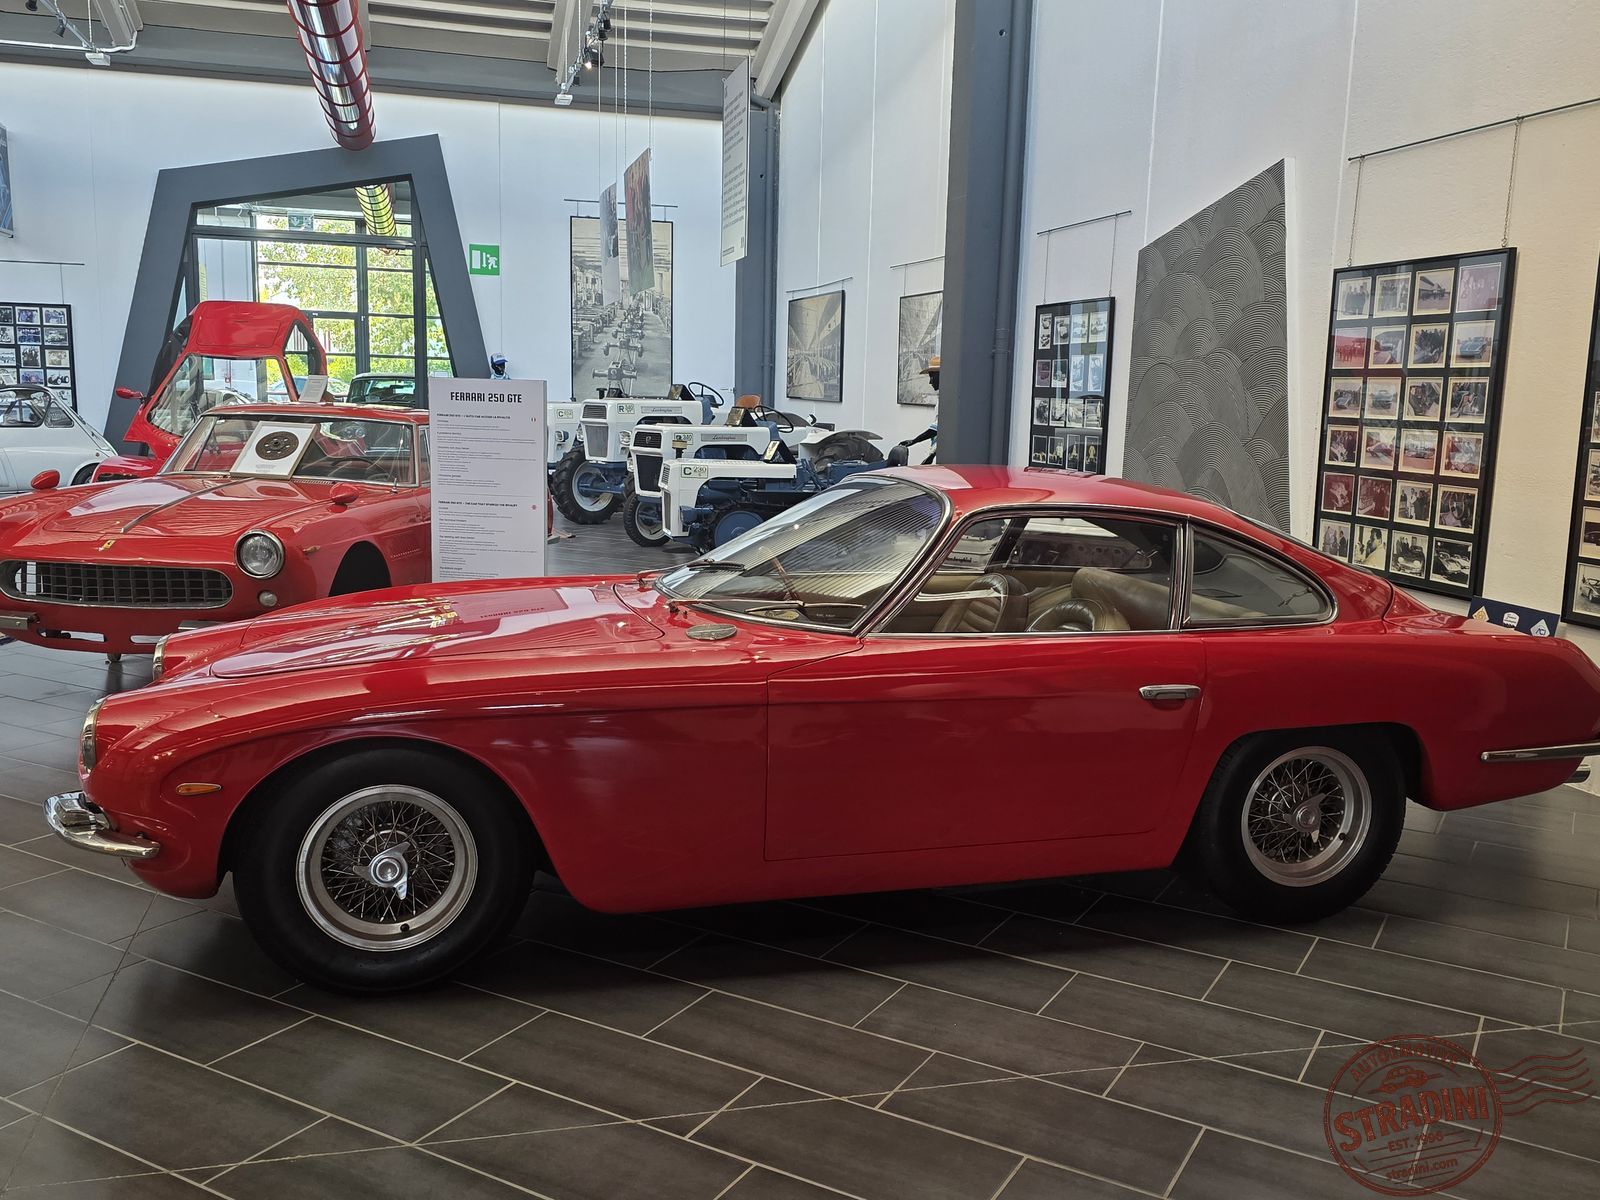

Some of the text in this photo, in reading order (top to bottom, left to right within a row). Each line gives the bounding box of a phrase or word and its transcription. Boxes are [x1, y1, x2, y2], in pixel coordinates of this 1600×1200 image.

[450, 391, 522, 403] FERRARI 250 GTE
[683, 466, 692, 476] C
